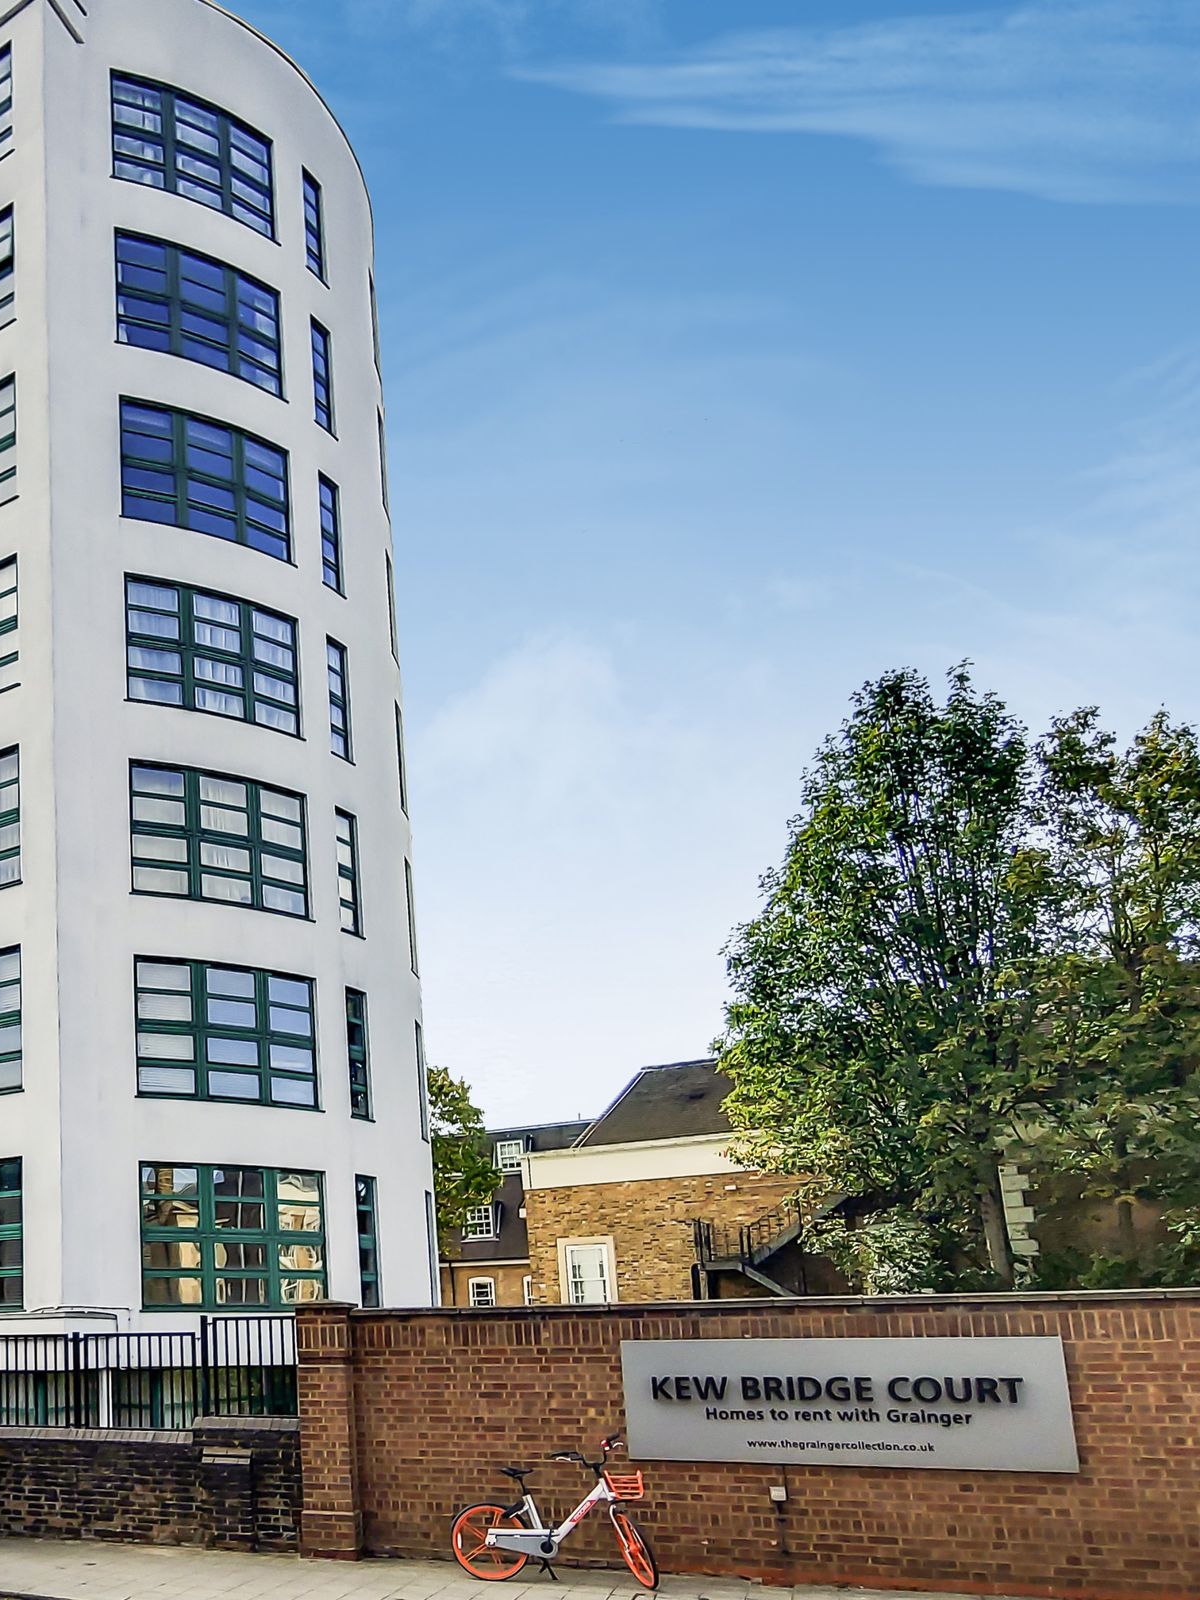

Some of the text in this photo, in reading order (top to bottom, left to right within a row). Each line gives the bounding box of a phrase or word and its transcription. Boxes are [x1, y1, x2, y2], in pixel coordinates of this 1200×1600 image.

[651, 1376, 1023, 1403] KEW BRIDGE COURT
[706, 1407, 972, 1427] Homes to rent with Grainger
[747, 1439, 935, 1452] www.thegraingercollection.co.uk
